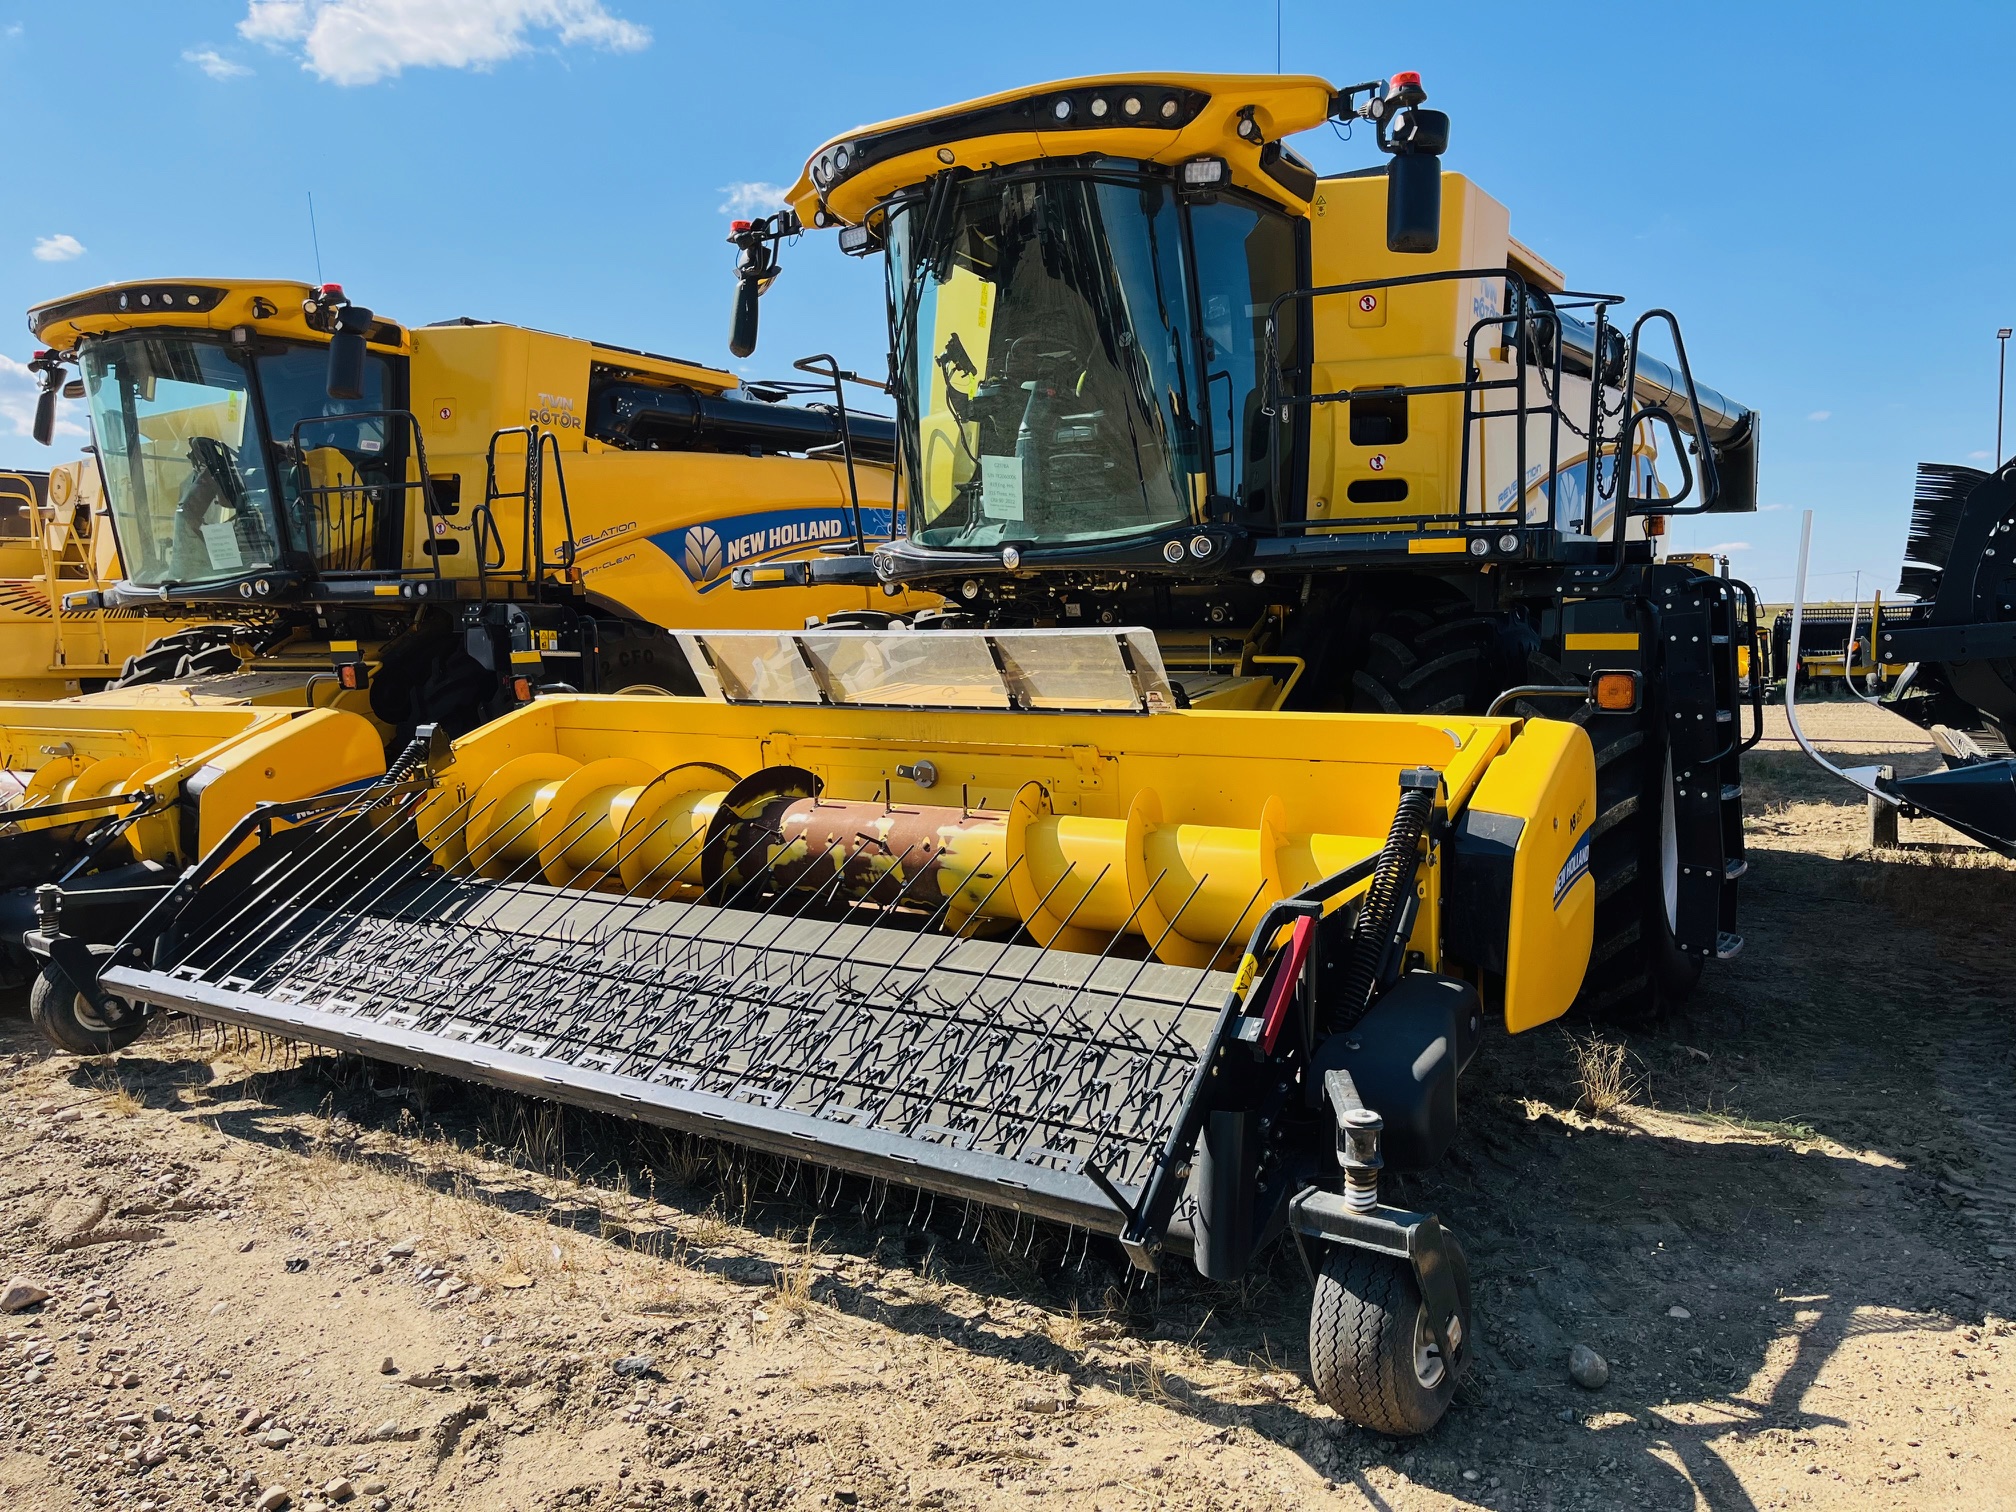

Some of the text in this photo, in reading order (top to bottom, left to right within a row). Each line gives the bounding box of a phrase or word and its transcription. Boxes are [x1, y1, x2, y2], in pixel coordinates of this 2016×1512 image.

[538, 393, 573, 411] TWIN
[530, 408, 581, 429] ROTOR
[554, 521, 637, 557] RVELATION
[728, 519, 842, 563] NEW HOLLAND
[581, 552, 636, 578] PTI-CLEAN
[1553, 866, 1567, 898] NEW
[1566, 844, 1590, 881] HOLLAND
